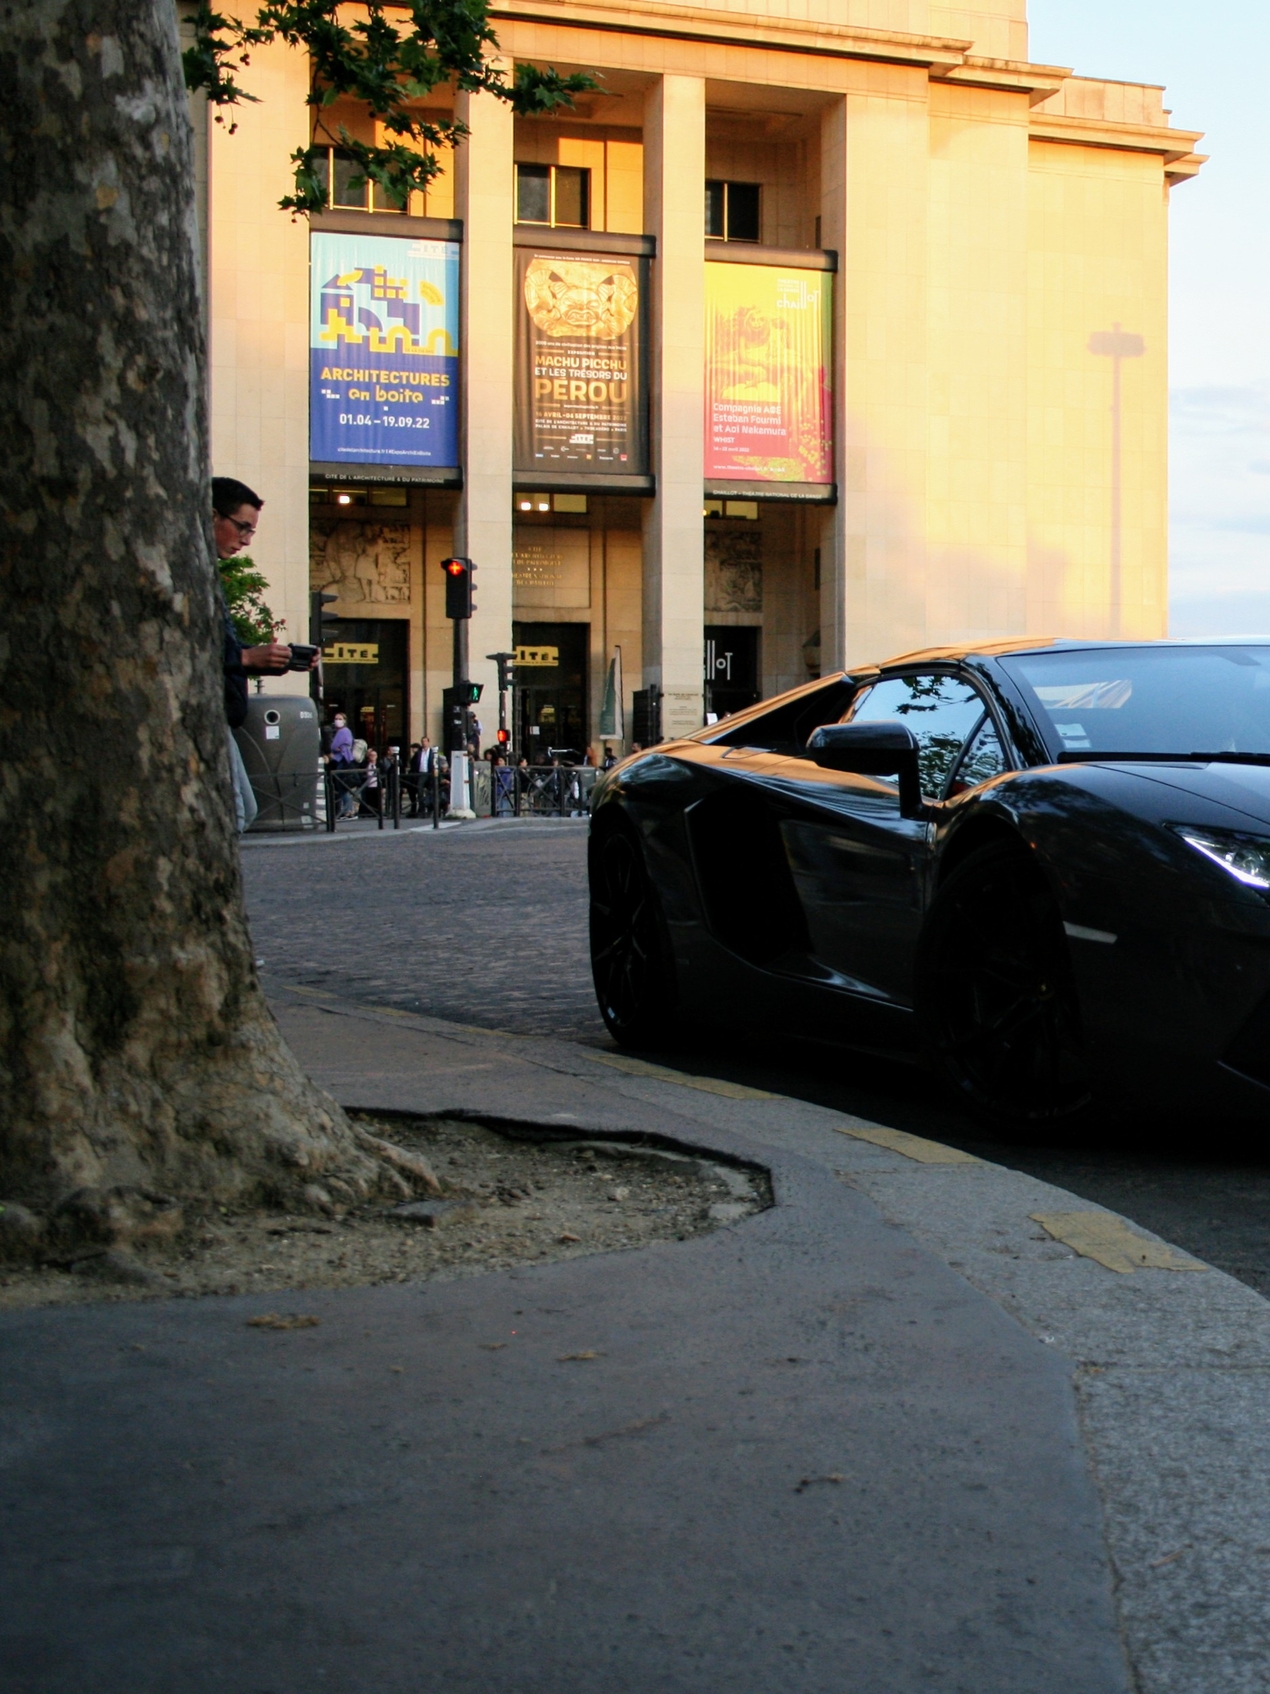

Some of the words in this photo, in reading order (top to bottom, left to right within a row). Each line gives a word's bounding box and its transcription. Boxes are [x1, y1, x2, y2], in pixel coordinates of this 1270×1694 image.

[535, 356, 580, 368] MACHU
[582, 358, 627, 370] PICCHU
[320, 366, 450, 386] ARCHITECTURES
[535, 367, 547, 376] ET
[549, 368, 567, 377] LES
[568, 368, 612, 380] TRÉSORS
[613, 372, 628, 380] DU
[348, 388, 370, 401] en
[535, 377, 627, 403] PÉROU
[340, 413, 372, 425] 01.04
[382, 416, 430, 429] 19.09.22
[713, 414, 749, 423] Esteban
[750, 415, 782, 424] Fourmi
[713, 424, 723, 432] et
[742, 425, 786, 436] Nakamura
